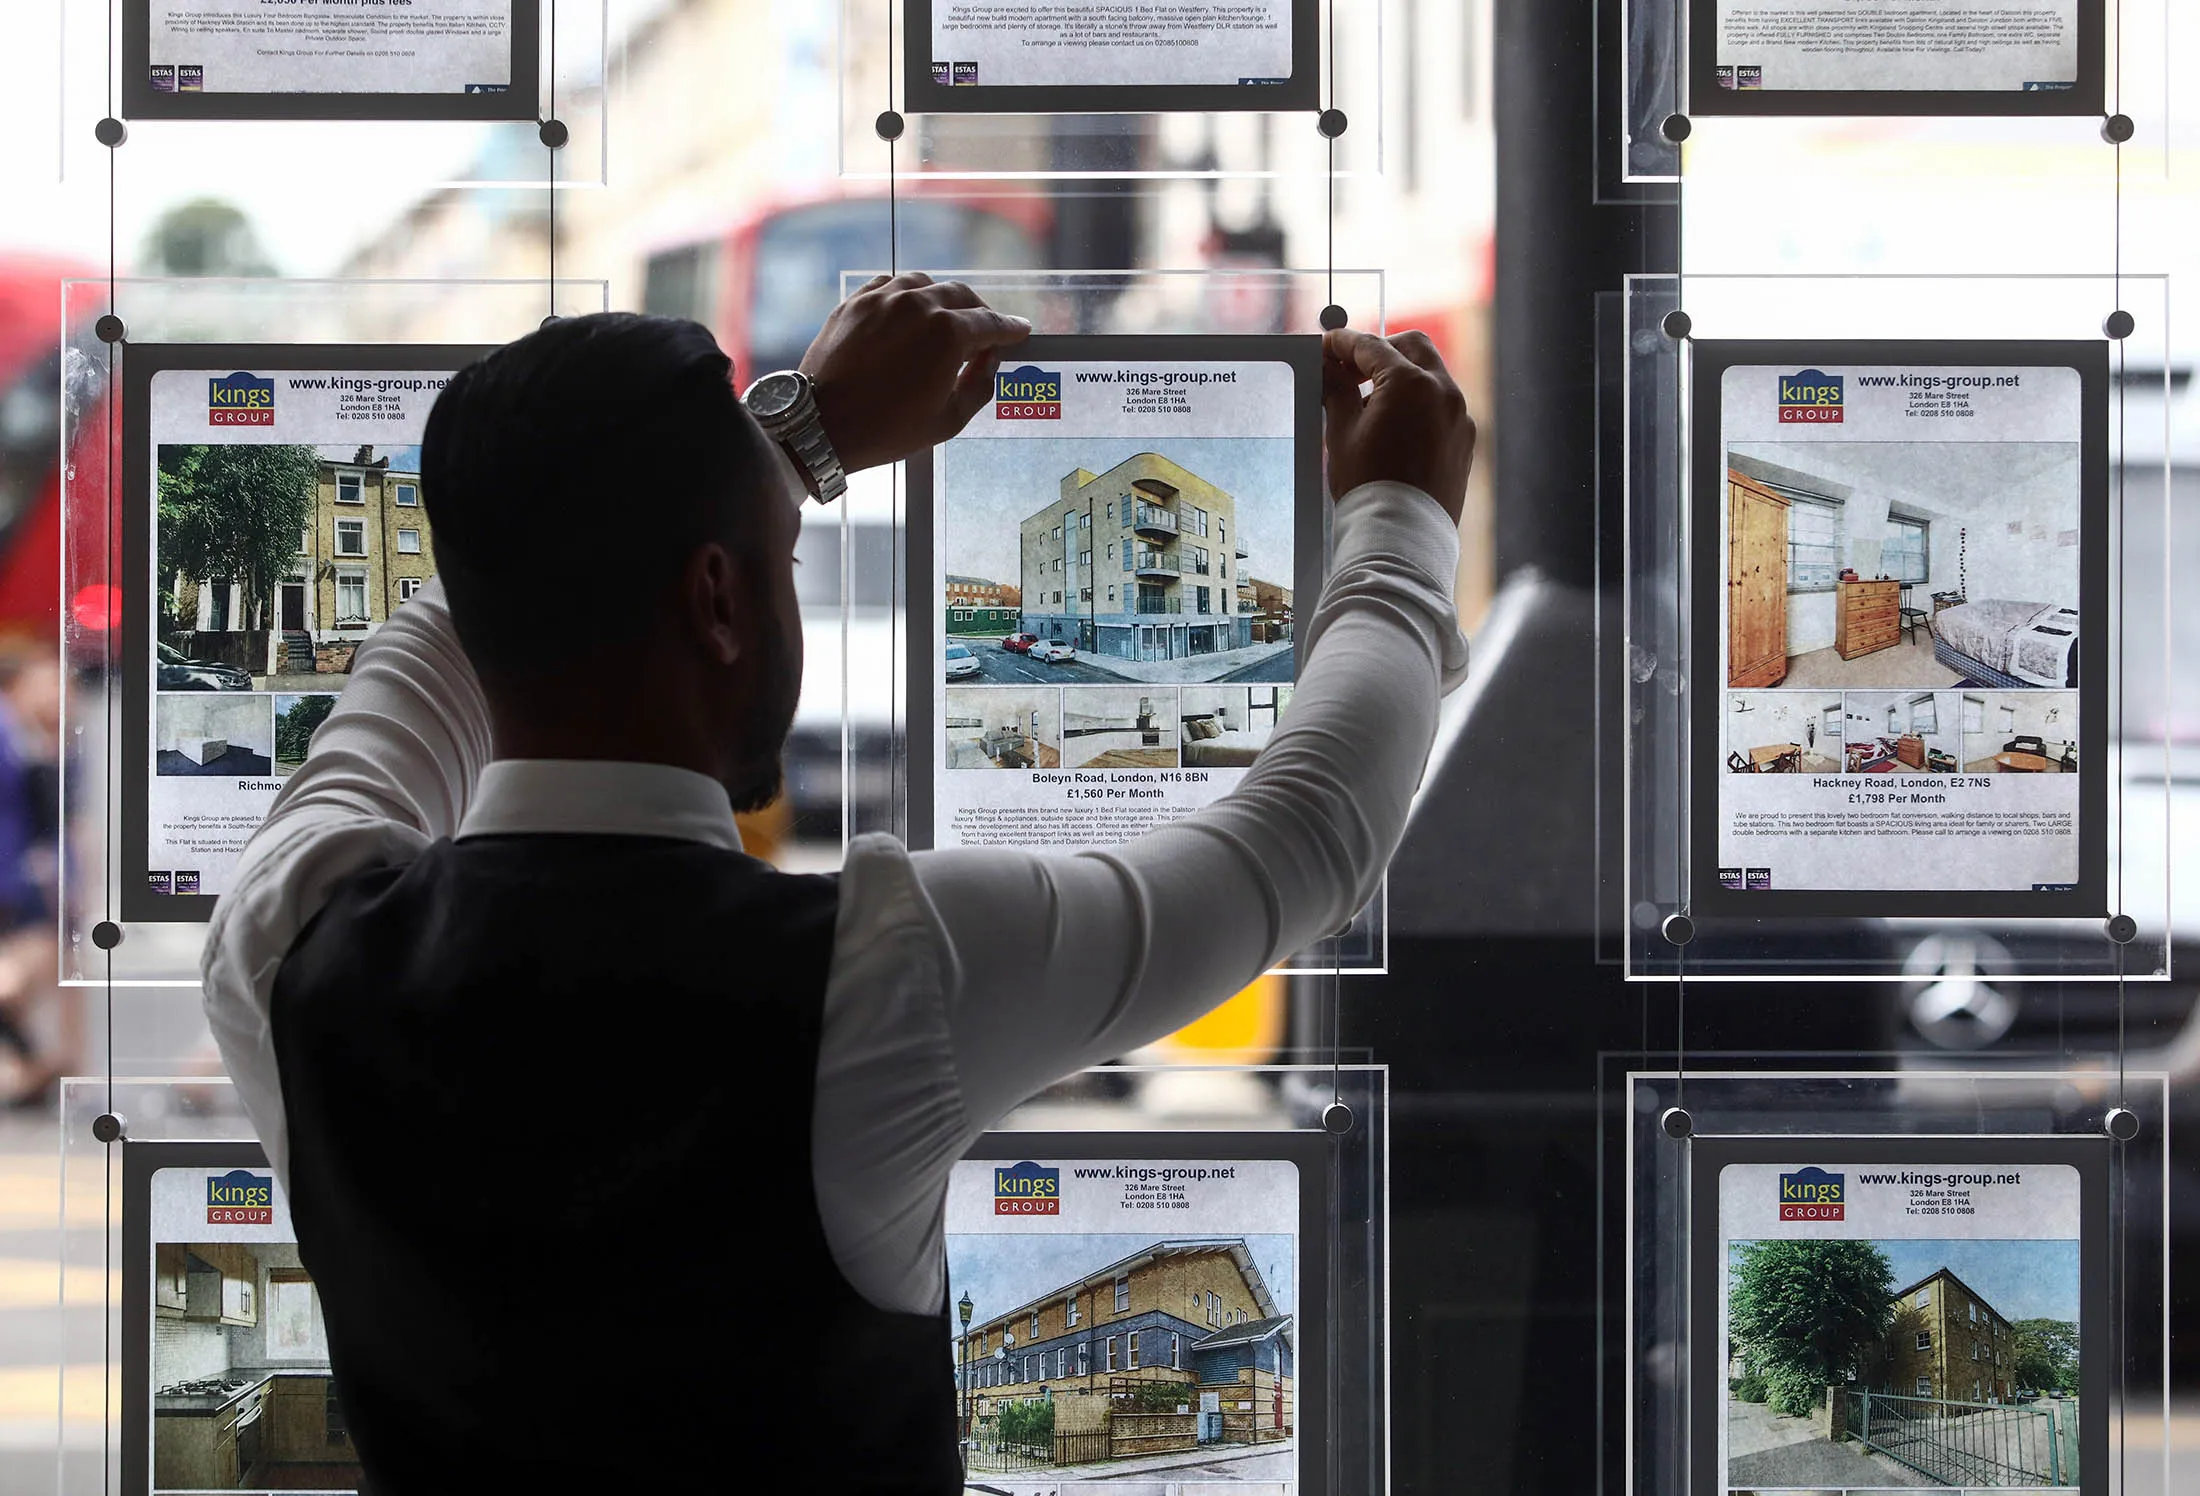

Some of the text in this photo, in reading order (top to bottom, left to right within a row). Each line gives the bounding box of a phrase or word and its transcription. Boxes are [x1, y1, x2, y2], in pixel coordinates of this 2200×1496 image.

[1076, 370, 1237, 385] www.kings-group.net
[1858, 374, 2019, 389] www.kings-group.net
[1000, 377, 1057, 402] kings
[1782, 379, 1840, 405] kings
[213, 382, 270, 408] kings
[340, 394, 400, 402] 326 Mare Street
[1126, 396, 1186, 404] London E8 1HA
[340, 403, 400, 411] London E8 1HA
[1909, 400, 1969, 408] London E8 1HA
[336, 412, 405, 420] Tel: 0208 510 0808
[1001, 406, 1057, 416] GROUP
[1783, 410, 1839, 420] GROUP
[214, 412, 271, 422] GROUP
[1032, 772, 1208, 786] Boleyn Road, London, N16 8BN
[1813, 777, 1990, 790] Hackney Road, London, E2 7NS
[238, 781, 283, 791] Richmo
[1067, 788, 1164, 800] £1,560 Per Month
[1848, 793, 1945, 805] £1,798 Per Month
[958, 807, 977, 815] Kings
[977, 807, 998, 815] Group
[998, 807, 1026, 815] presents
[1759, 812, 1779, 820] proud
[1787, 812, 1813, 820] present
[1826, 812, 1845, 820] lovely
[1940, 812, 1965, 820] walking
[2019, 812, 2040, 820] shops,
[173, 823, 197, 831] property
[1074, 1166, 1235, 1181] www.kings-group.net
[1859, 1172, 2021, 1187] www.kings-group.net
[998, 1172, 1056, 1198] kings
[1783, 1177, 1841, 1203] kings
[211, 1181, 269, 1207] kings
[1124, 1192, 1184, 1200] London E8 1HA
[1000, 1202, 1055, 1212] GROUP
[1910, 1198, 1970, 1206] London E8 1HA
[212, 1210, 268, 1221] GROUP
[1784, 1208, 1840, 1218] GROUP
